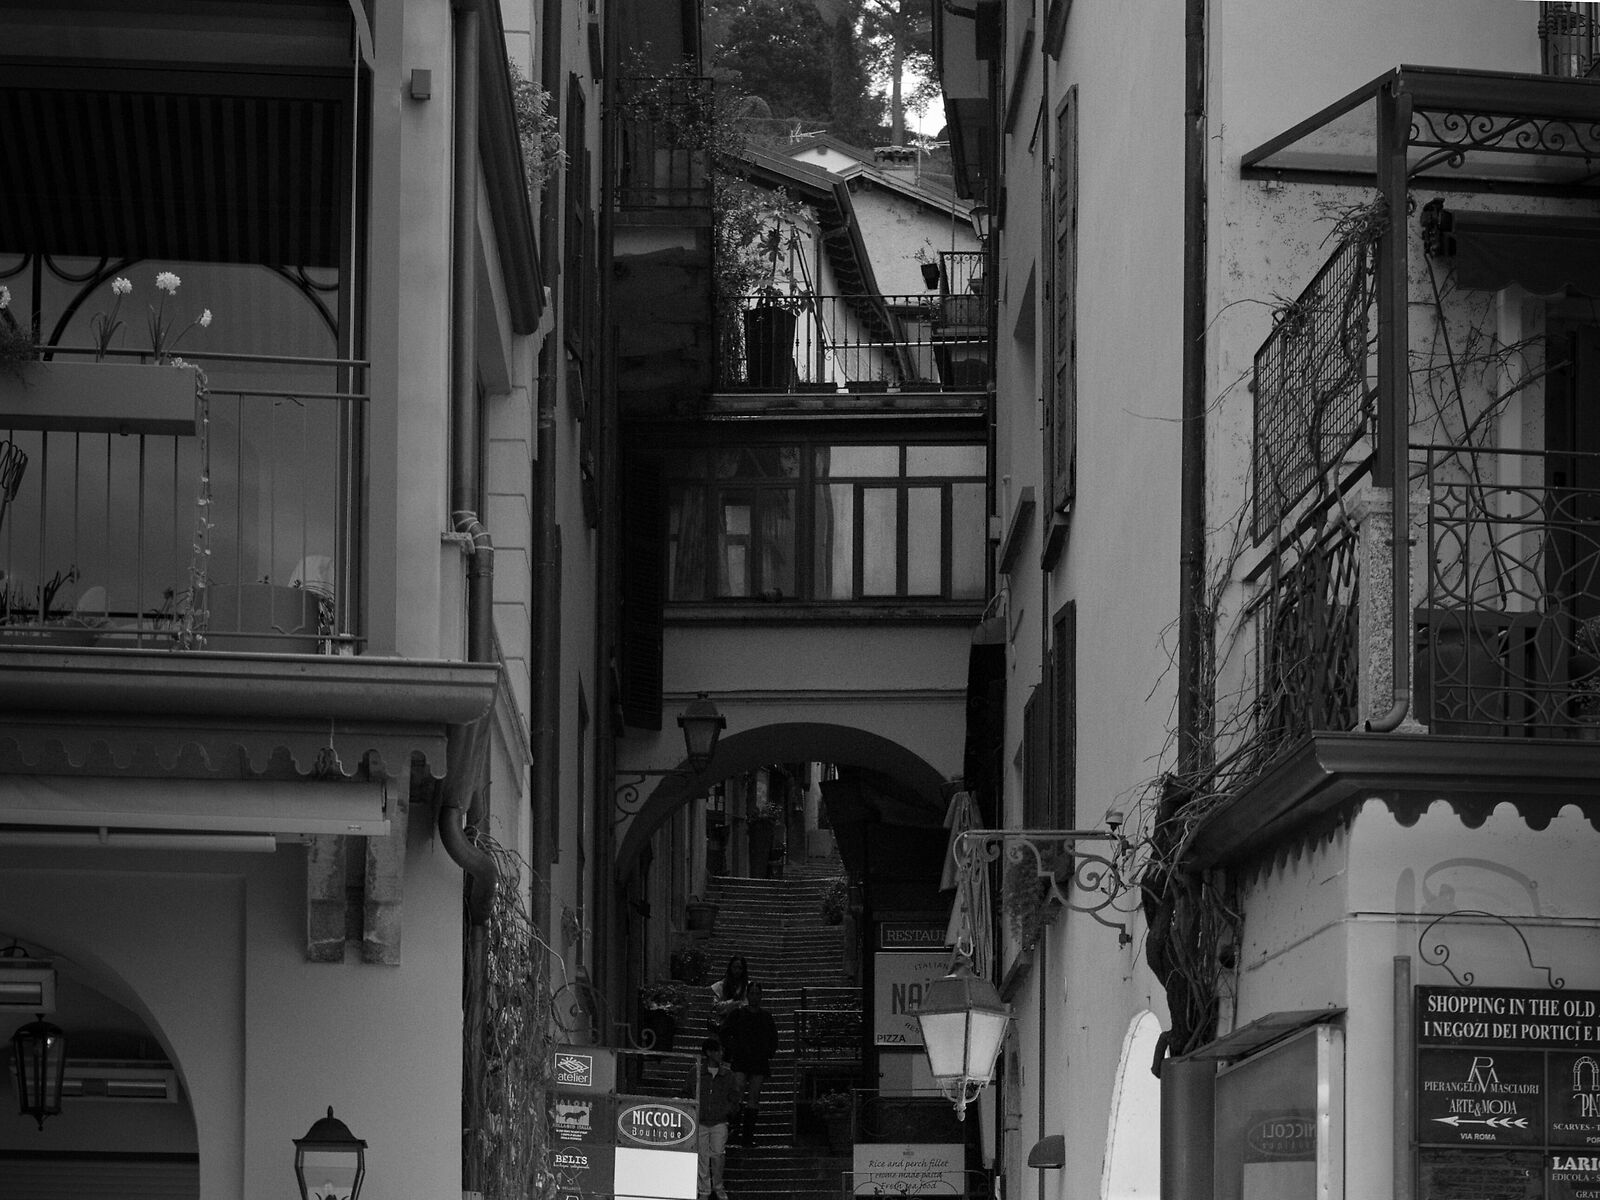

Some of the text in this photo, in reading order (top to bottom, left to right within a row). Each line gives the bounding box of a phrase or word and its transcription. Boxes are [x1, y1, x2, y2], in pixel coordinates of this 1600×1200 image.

[1427, 994, 1596, 1017] SHOPPING IN THE OLD
[1424, 1021, 1593, 1041] I NEGOZI DEI PORTICI E
[876, 1034, 906, 1043] PIZZA
[557, 1073, 589, 1084] atelier
[1424, 1081, 1539, 1095] PIERANGELO MASCIADRI
[632, 1110, 682, 1128] NICCOLI
[1552, 1123, 1590, 1131] SCARVES
[632, 1128, 682, 1140] Boutique
[1460, 1132, 1496, 1141] VIA ROMA
[555, 1154, 588, 1165] BELTS
[1552, 1156, 1600, 1171] LARI
[1552, 1173, 1589, 1182] EDICOLA
